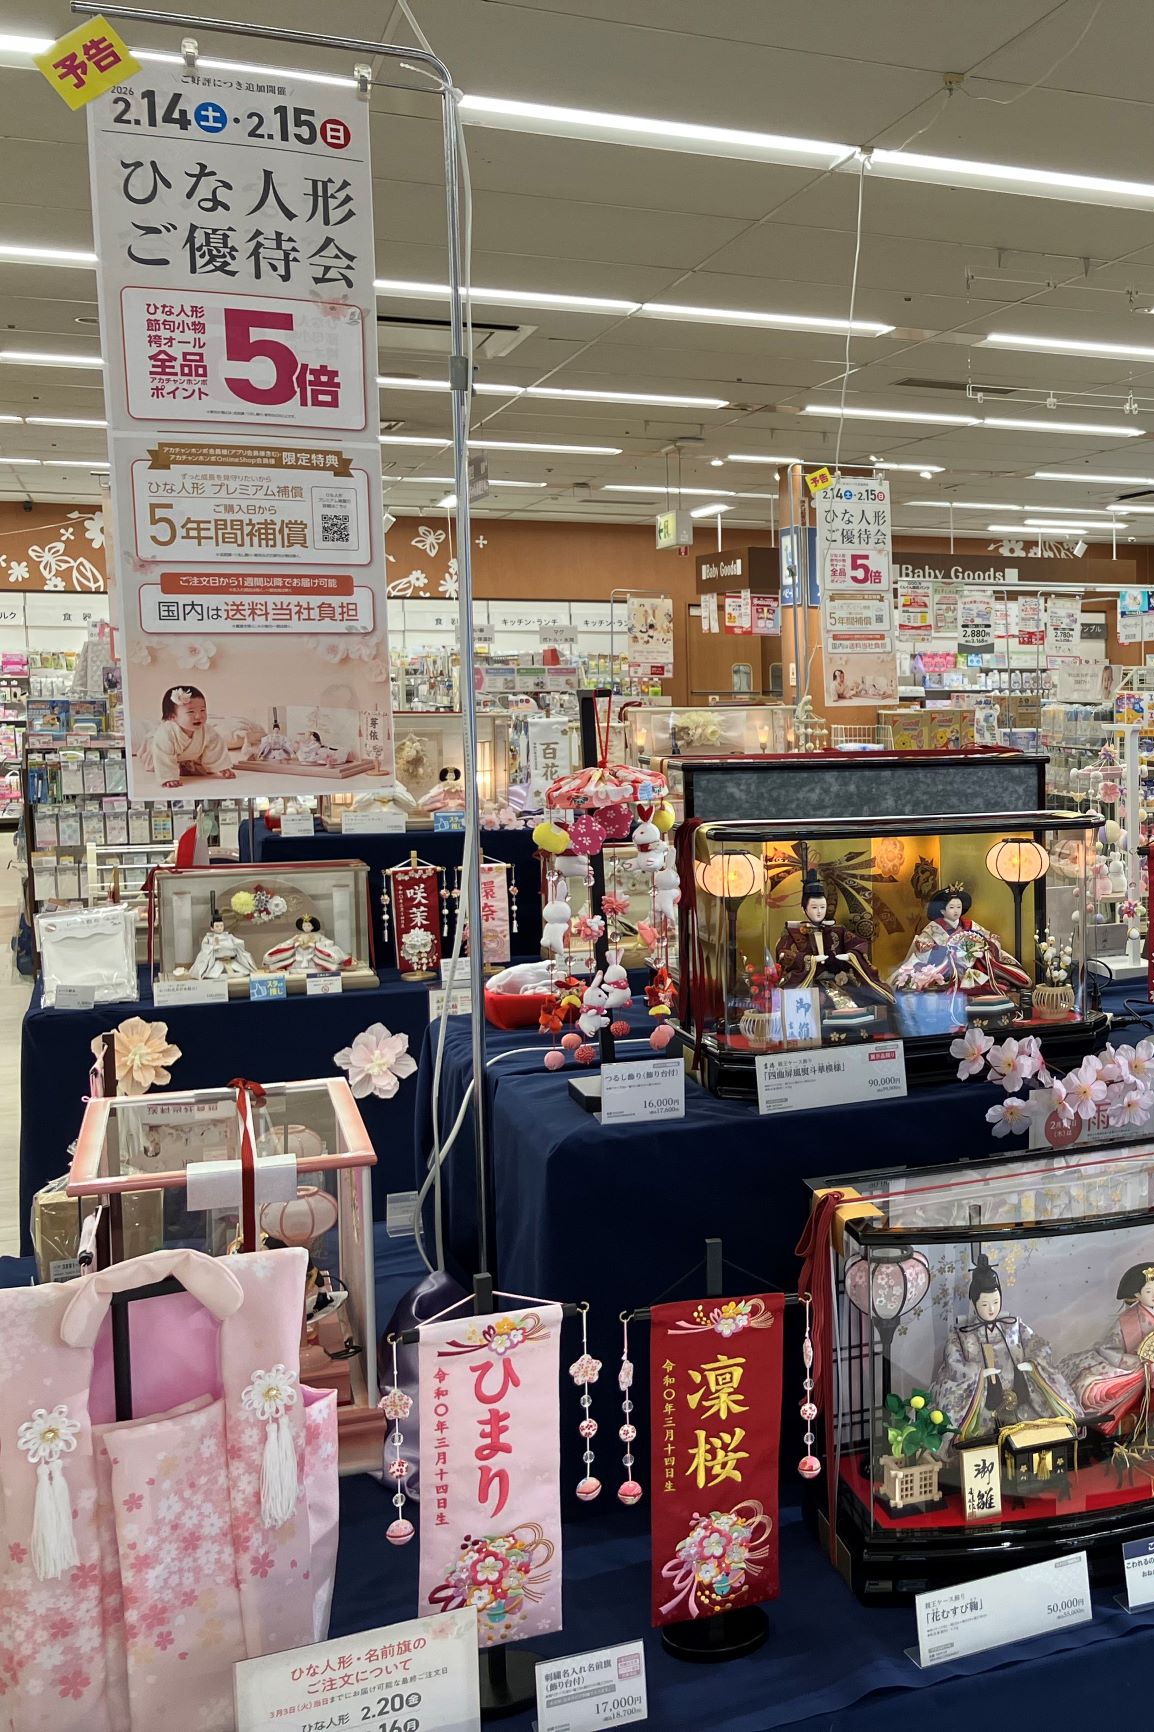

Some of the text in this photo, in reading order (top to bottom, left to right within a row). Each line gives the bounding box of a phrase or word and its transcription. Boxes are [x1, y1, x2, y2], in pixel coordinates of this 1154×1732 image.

[52, 36, 122, 89] 予告
[111, 84, 135, 96] 2026
[181, 74, 287, 97] ご好評につき追加開催
[120, 159, 357, 227] ひな人形
[127, 222, 358, 289] ご優待会
[146, 303, 205, 318] ひな人形
[146, 318, 206, 334] 節句小物
[147, 333, 206, 349] 袴オール
[148, 349, 208, 378] 全品
[151, 385, 209, 400] ポイント
[282, 452, 339, 467] 限定特典
[810, 473, 829, 488] 予告
[148, 481, 305, 499] ひな人形 プレミアム補償
[213, 503, 277, 515] ご購入日から
[824, 509, 887, 526] ひな人形
[149, 502, 309, 550] 5年間補償
[825, 528, 887, 546] ご優待会
[705, 559, 738, 580] Baby Goods
[830, 567, 847, 577] 全品
[901, 565, 1005, 582] Baby Goods
[179, 576, 338, 588] ご注文日から1週間以降でお届け可能
[157, 600, 360, 623] 国内は送料当社負担
[501, 617, 559, 626] キッチン・ランチ
[539, 741, 560, 781] 百花
[405, 883, 431, 927] 咲茉
[868, 1076, 901, 1088] 90,000円
[643, 1097, 680, 1109] 16,000円
[469, 1356, 522, 1520] ひまり
[1047, 1597, 1084, 1615] 50,000円
[291, 1637, 427, 1682] ひな人形・名前旗の
[307, 1658, 414, 1695] ご注文について
[545, 1659, 612, 1682] 刺繍名入れ名前旗
[595, 1695, 642, 1715] 17,000円
[302, 1712, 350, 1732] ひな人形
